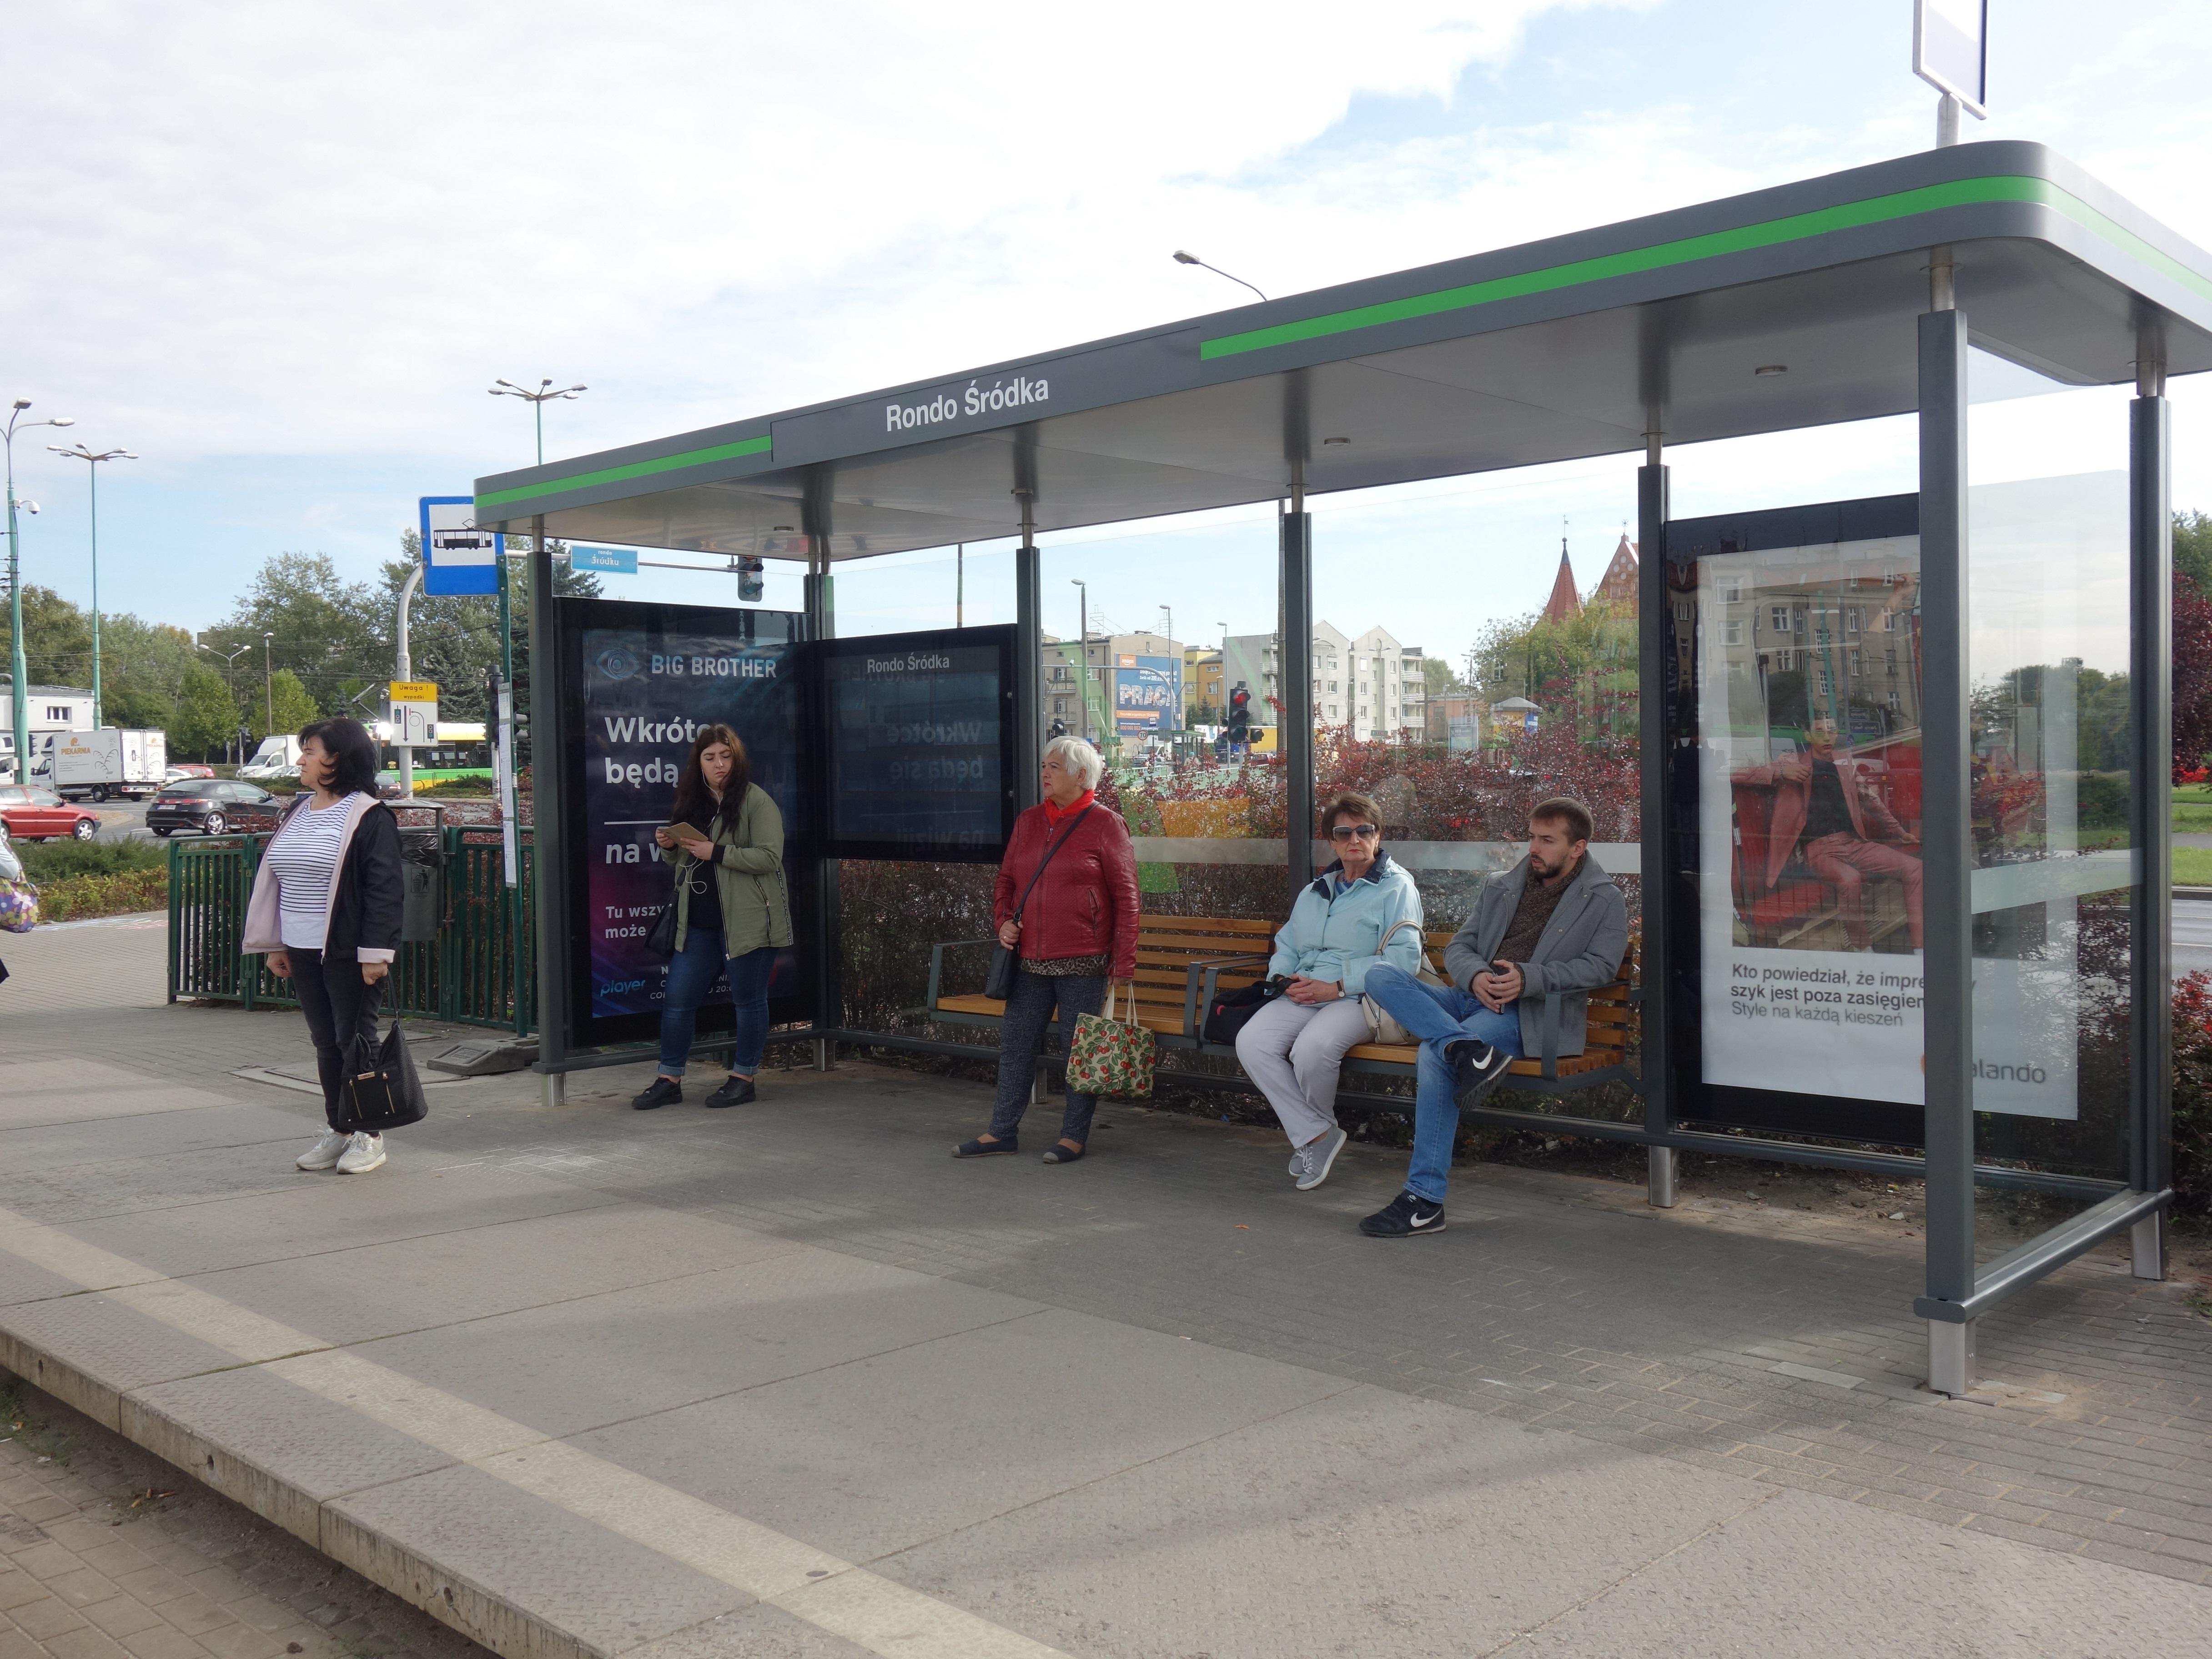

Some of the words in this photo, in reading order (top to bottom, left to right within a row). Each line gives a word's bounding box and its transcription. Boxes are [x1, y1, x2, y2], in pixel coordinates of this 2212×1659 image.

[886, 395, 957, 432] Rondo
[965, 377, 1049, 416] Śródka
[652, 655, 684, 674] BIG
[691, 656, 777, 678] BROTHER
[867, 657, 904, 673] Rondo
[908, 652, 950, 670] Śródka
[1120, 684, 1177, 706] PRACA
[604, 715, 724, 743] Wkrót
[61, 747, 91, 755] PIEKARNIA
[605, 757, 679, 789] będą
[606, 843, 639, 864] na
[605, 906, 623, 919] Tu
[628, 905, 664, 917] wszy
[605, 924, 646, 939] może
[600, 979, 646, 997] player
[1732, 964, 1758, 978] Kto
[1763, 967, 1850, 987] powiedział,
[1856, 970, 1875, 985] że
[1880, 972, 1924, 991] impre
[715, 985, 732, 993] 20:
[1731, 985, 1765, 1000] szyk
[1770, 985, 1799, 1002] jest
[1804, 990, 1842, 1004] poza
[1732, 1001, 1767, 1019] Style
[1772, 1006, 1790, 1019] na
[1795, 1005, 1840, 1026] każdą
[1845, 1008, 1903, 1026] kieszeń
[1972, 1058, 2046, 1083] lando
